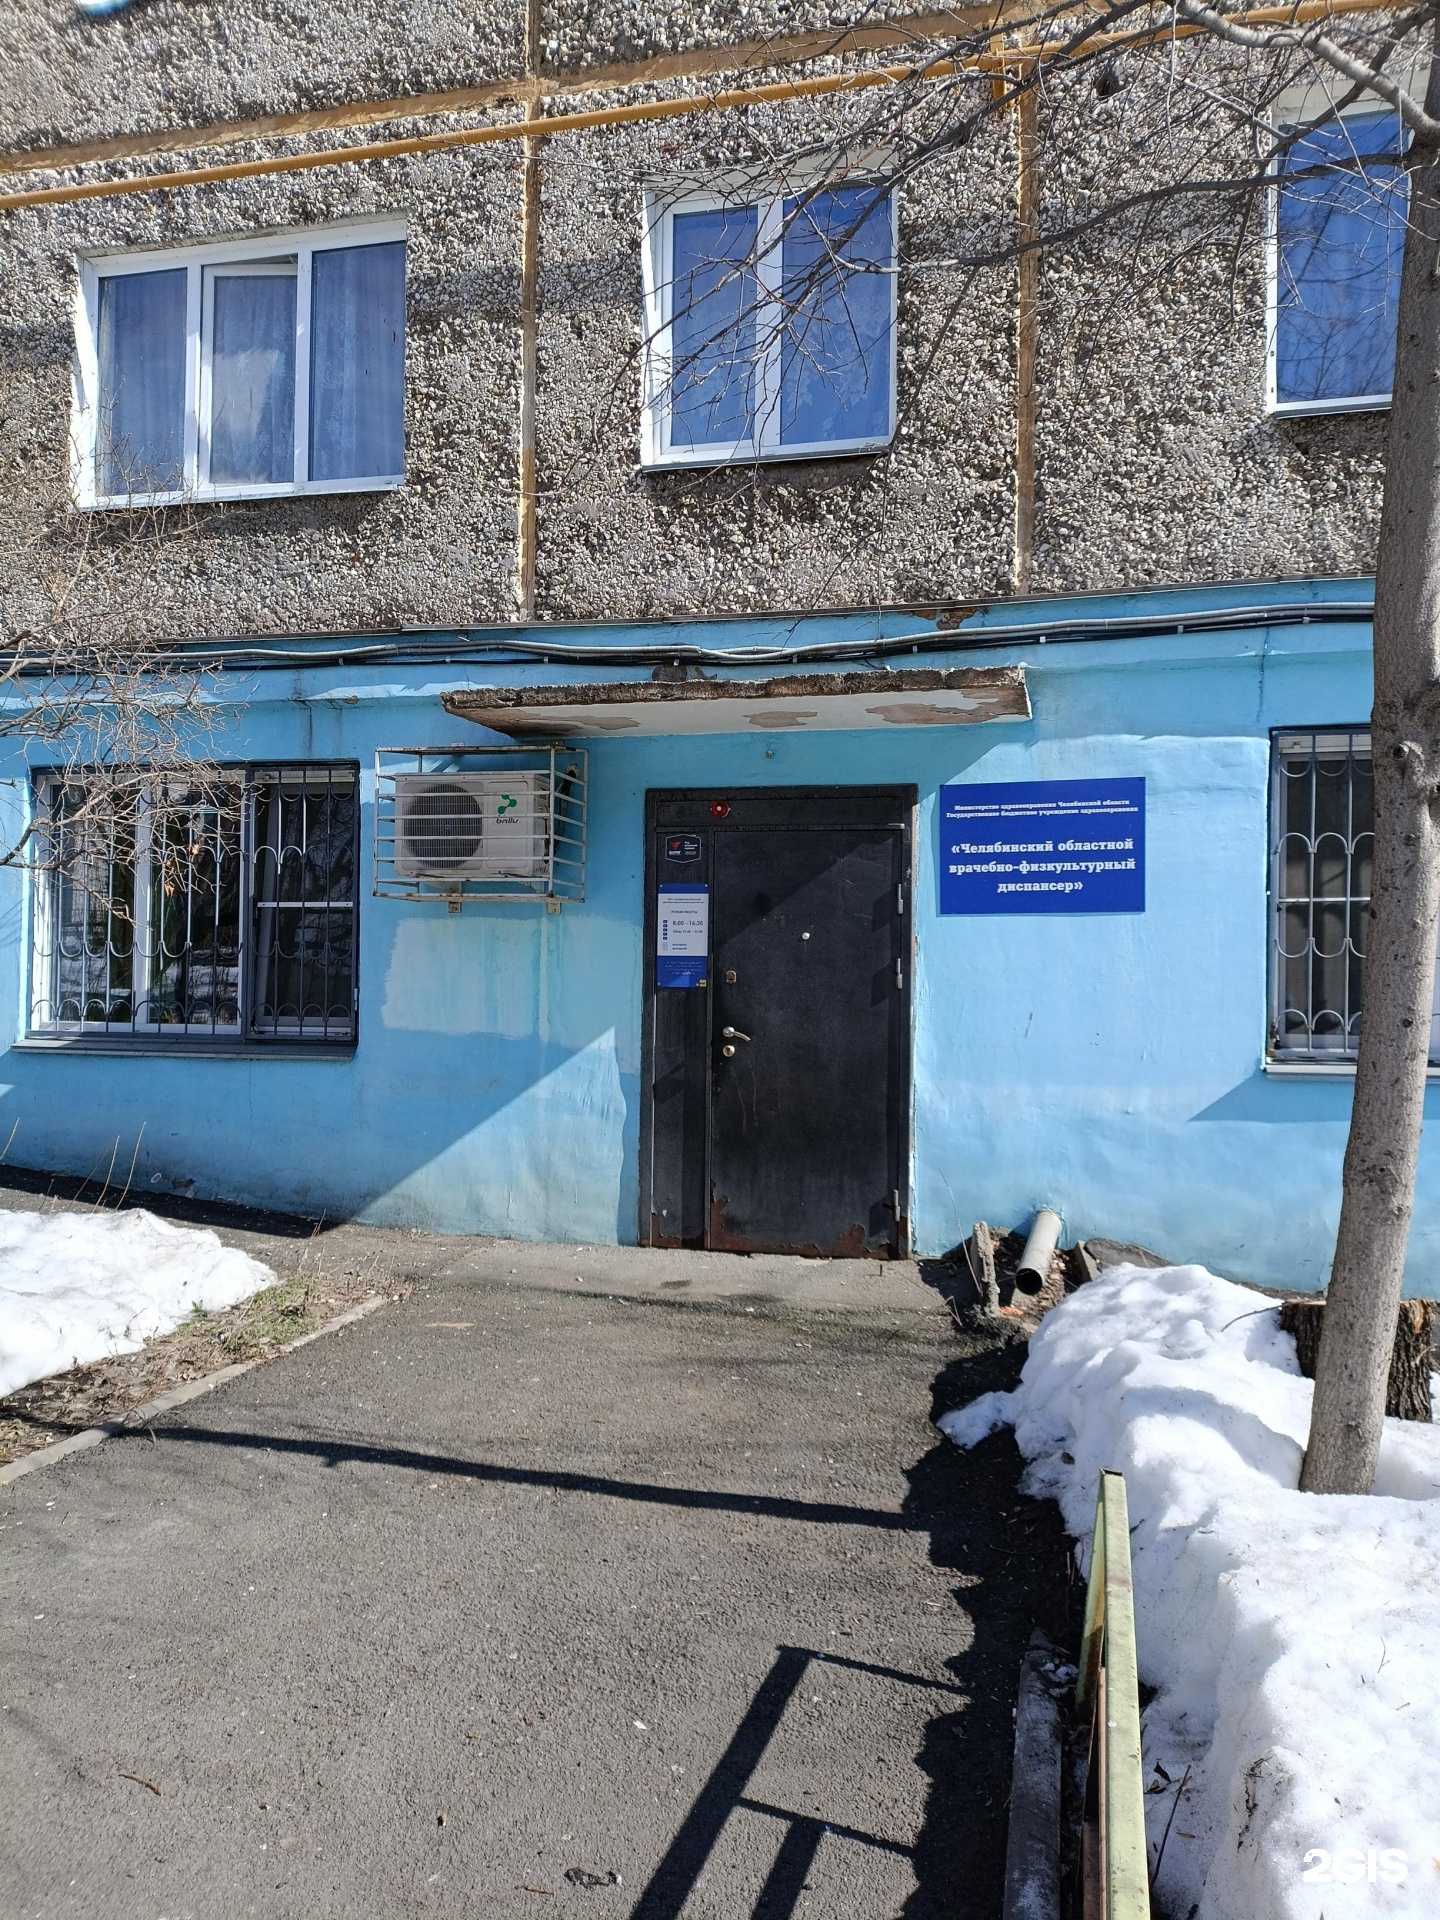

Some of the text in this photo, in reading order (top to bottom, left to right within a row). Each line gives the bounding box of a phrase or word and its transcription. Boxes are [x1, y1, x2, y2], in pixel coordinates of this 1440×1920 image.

[951, 838, 1134, 854] «Челябинский областной
[949, 858, 1136, 875] врачебно-физкультурный
[997, 881, 1084, 893] диспансер»
